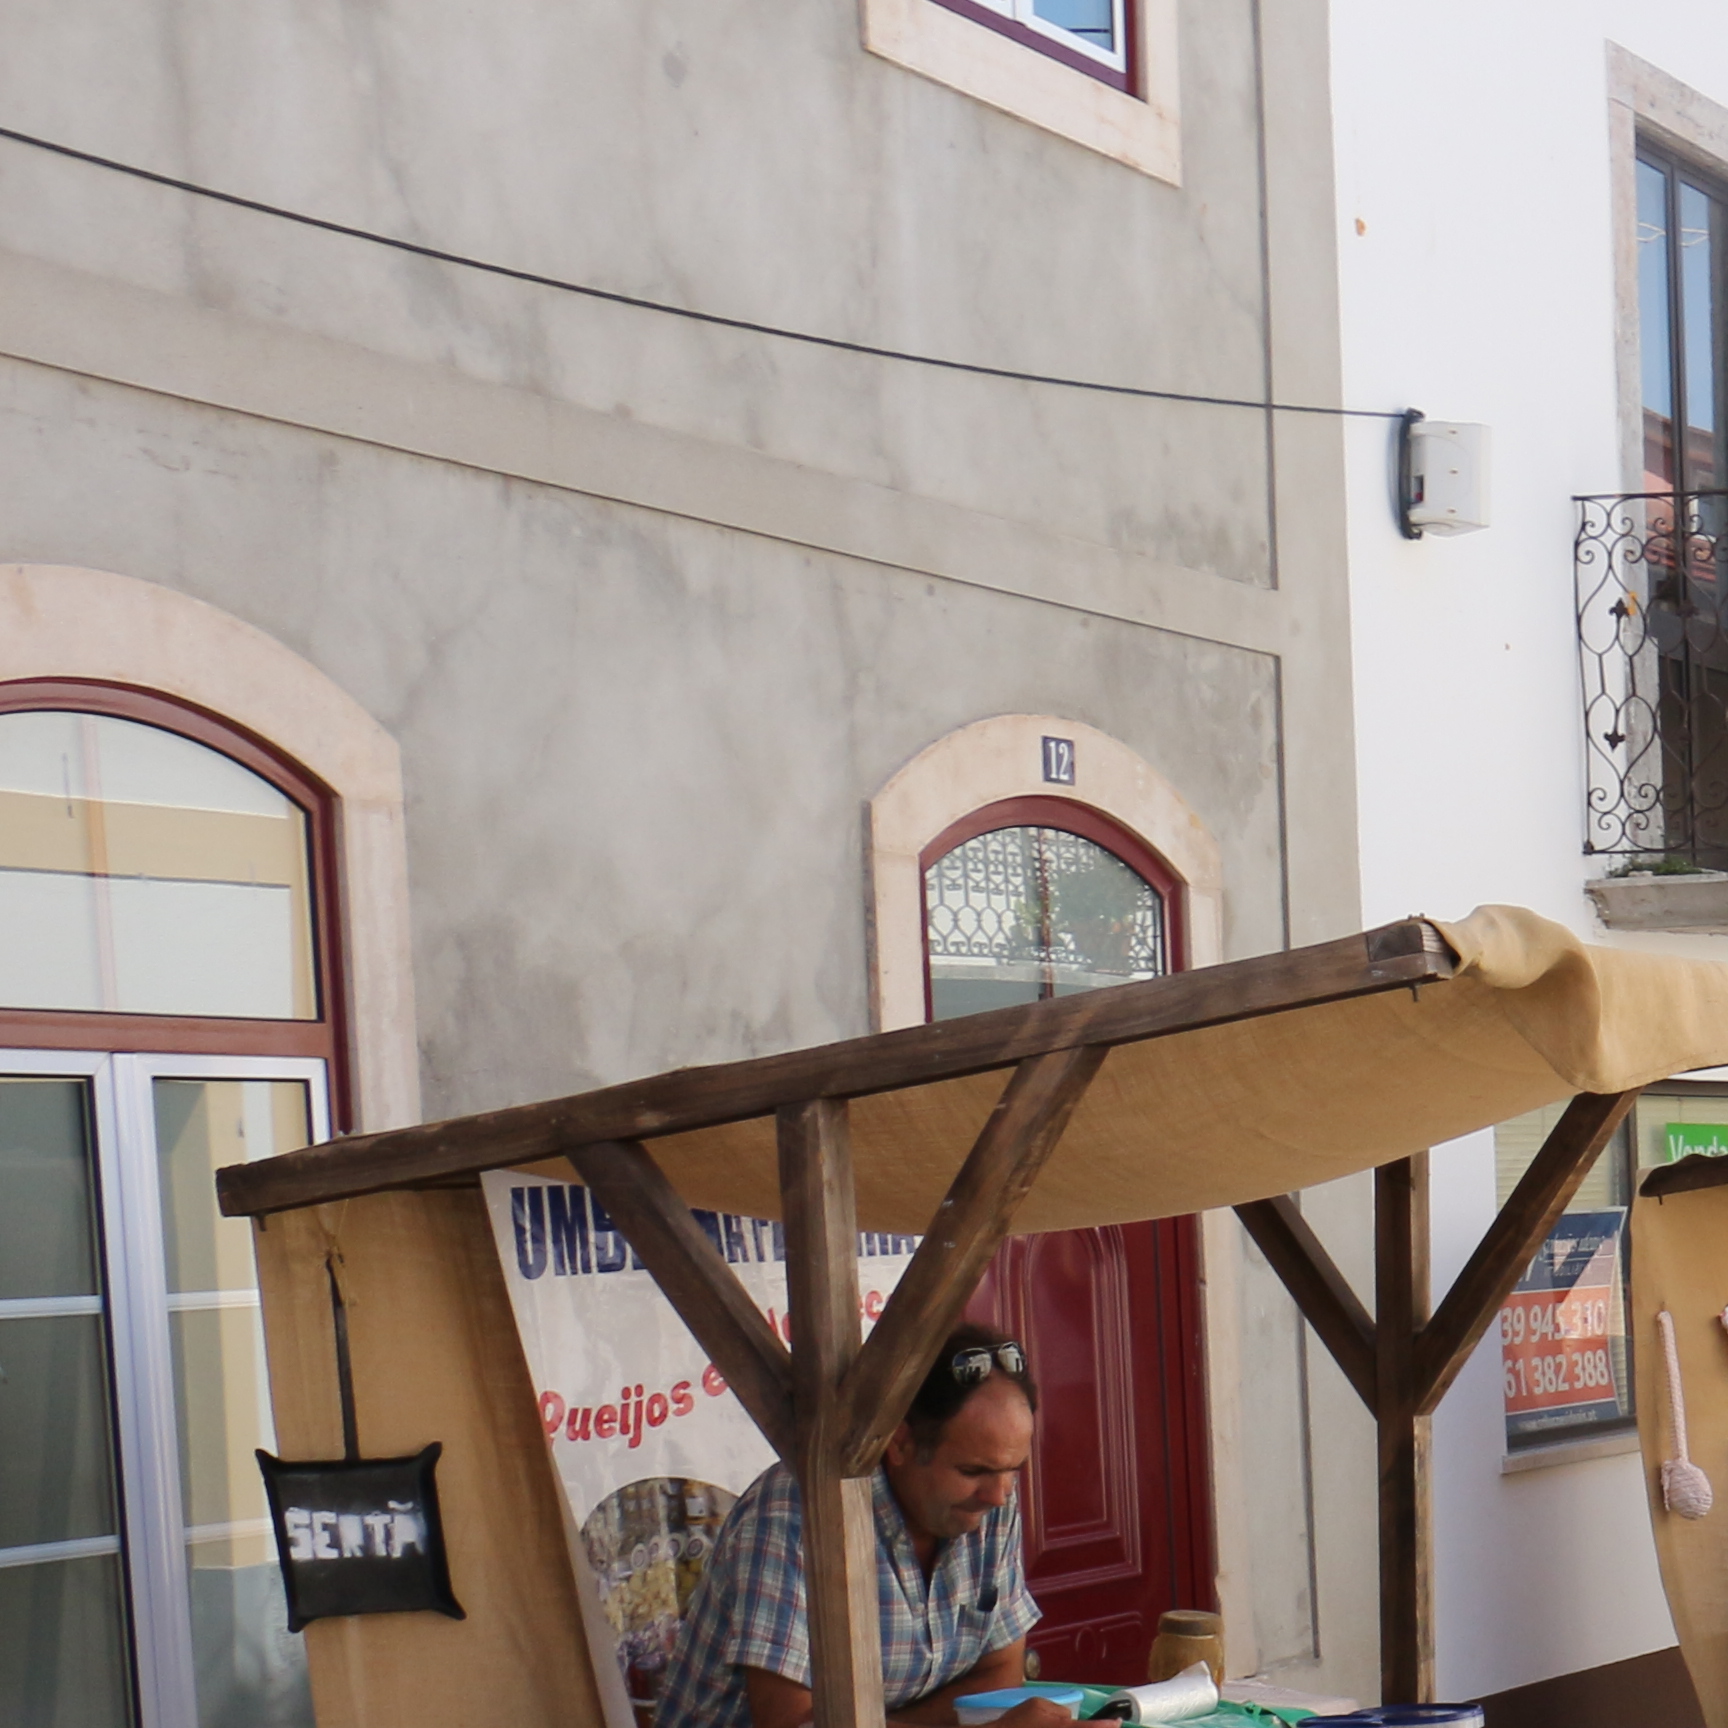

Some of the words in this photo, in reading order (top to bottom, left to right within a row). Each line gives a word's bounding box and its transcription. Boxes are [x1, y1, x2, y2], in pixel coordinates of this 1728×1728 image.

[1048, 740, 1070, 781] 12
[1501, 1306, 1526, 1346] 39
[1529, 1303, 1568, 1344] 945
[1503, 1358, 1527, 1398] 61
[1531, 1354, 1570, 1395] 382
[1571, 1349, 1609, 1390] 388
[539, 1380, 694, 1449] Queijos
